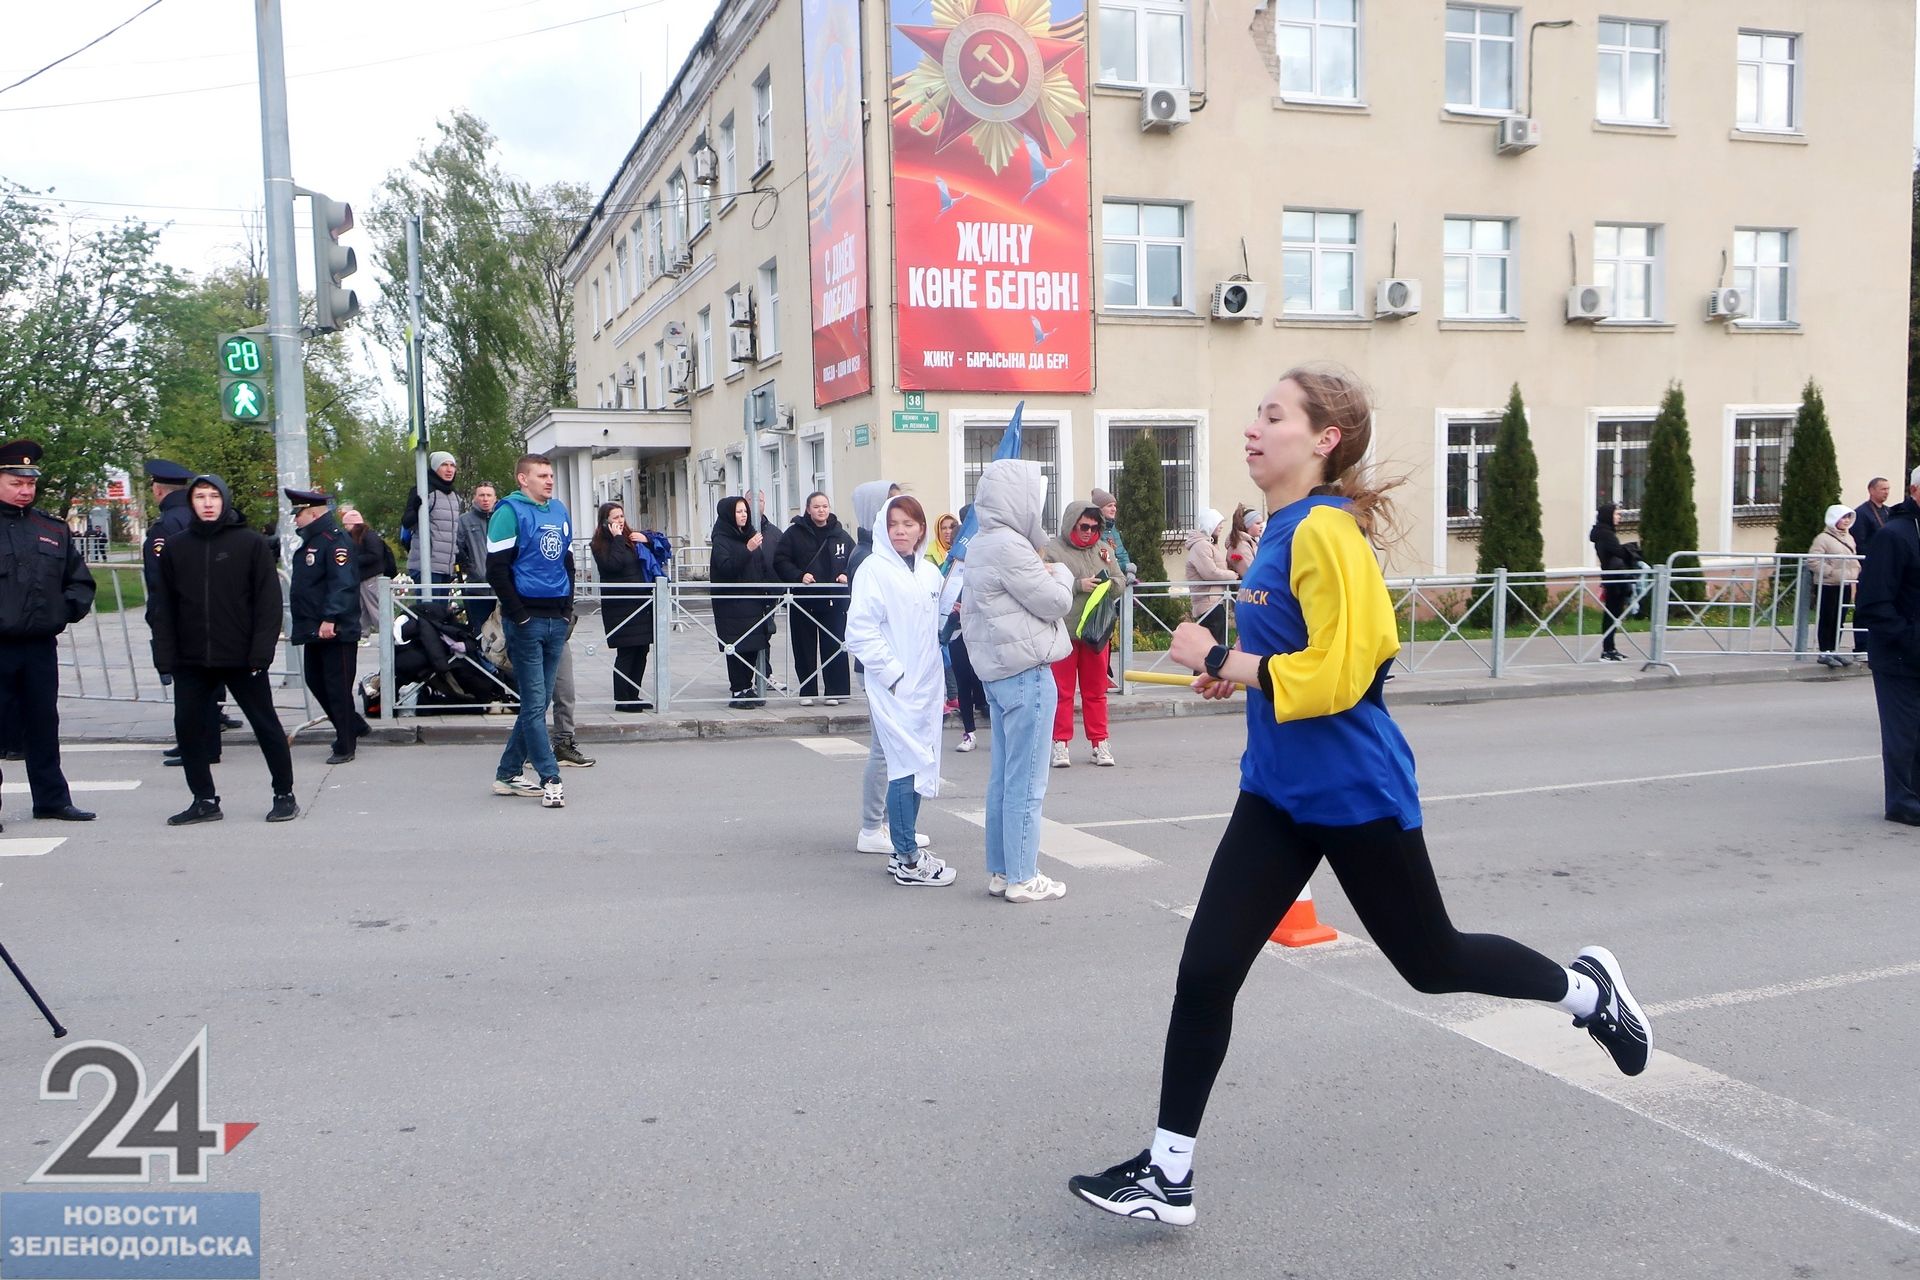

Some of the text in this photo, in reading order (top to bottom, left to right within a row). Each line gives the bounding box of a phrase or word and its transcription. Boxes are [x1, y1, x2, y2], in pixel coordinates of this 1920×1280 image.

[908, 266, 1079, 311] КӨНЕ БЕЛӘН!
[227, 342, 260, 373] 28
[966, 351, 1025, 369] БАРЫСЫНА
[1028, 352, 1044, 370] ДА
[1046, 352, 1069, 370] БЕР!
[908, 395, 921, 406] 38
